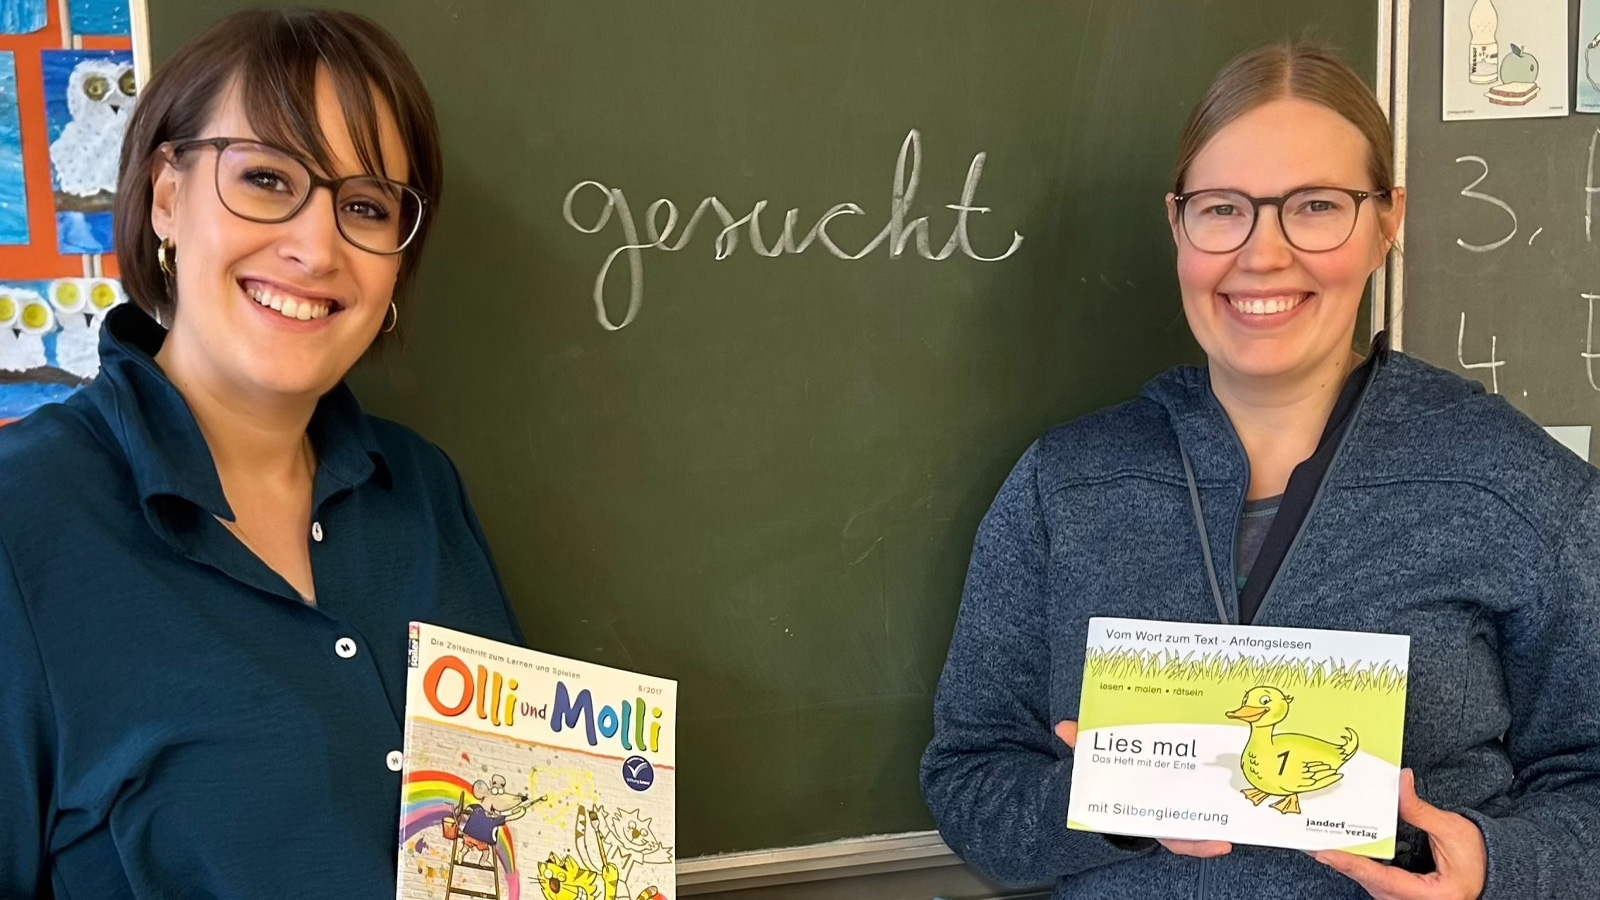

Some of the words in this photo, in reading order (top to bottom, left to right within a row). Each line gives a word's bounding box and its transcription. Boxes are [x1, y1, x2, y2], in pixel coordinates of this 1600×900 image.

[562, 128, 1025, 332] gesucht
[1106, 628, 1132, 640] Vom
[1135, 630, 1163, 642] Wort
[1165, 634, 1190, 644] zum
[1194, 634, 1218, 646] Text
[1229, 636, 1312, 650] Anfangslesen
[430, 638, 444, 647] Die
[447, 641, 487, 659] Zeitschrift
[488, 653, 505, 663] zum
[507, 657, 533, 670] Lernen
[535, 664, 550, 674] und
[552, 667, 581, 679] Spielen
[638, 685, 663, 696] 5/2017
[1099, 682, 1124, 691] lesen
[1134, 685, 1162, 694] malen
[1172, 687, 1204, 697] rätseln
[423, 655, 518, 727] Olli
[550, 680, 663, 753] Molli
[1093, 732, 1143, 754] Lies
[1152, 739, 1197, 758] mal
[1092, 754, 1111, 764] Das
[1114, 756, 1134, 766] Heft
[1137, 758, 1152, 767] mit
[1154, 759, 1171, 769] der
[1173, 760, 1196, 770] Ente
[1277, 750, 1290, 776] 1
[1087, 803, 1109, 814] mit
[1112, 803, 1229, 826] Silbengliederung
[1306, 818, 1346, 829] jandorf
[1345, 829, 1378, 840] verlag
